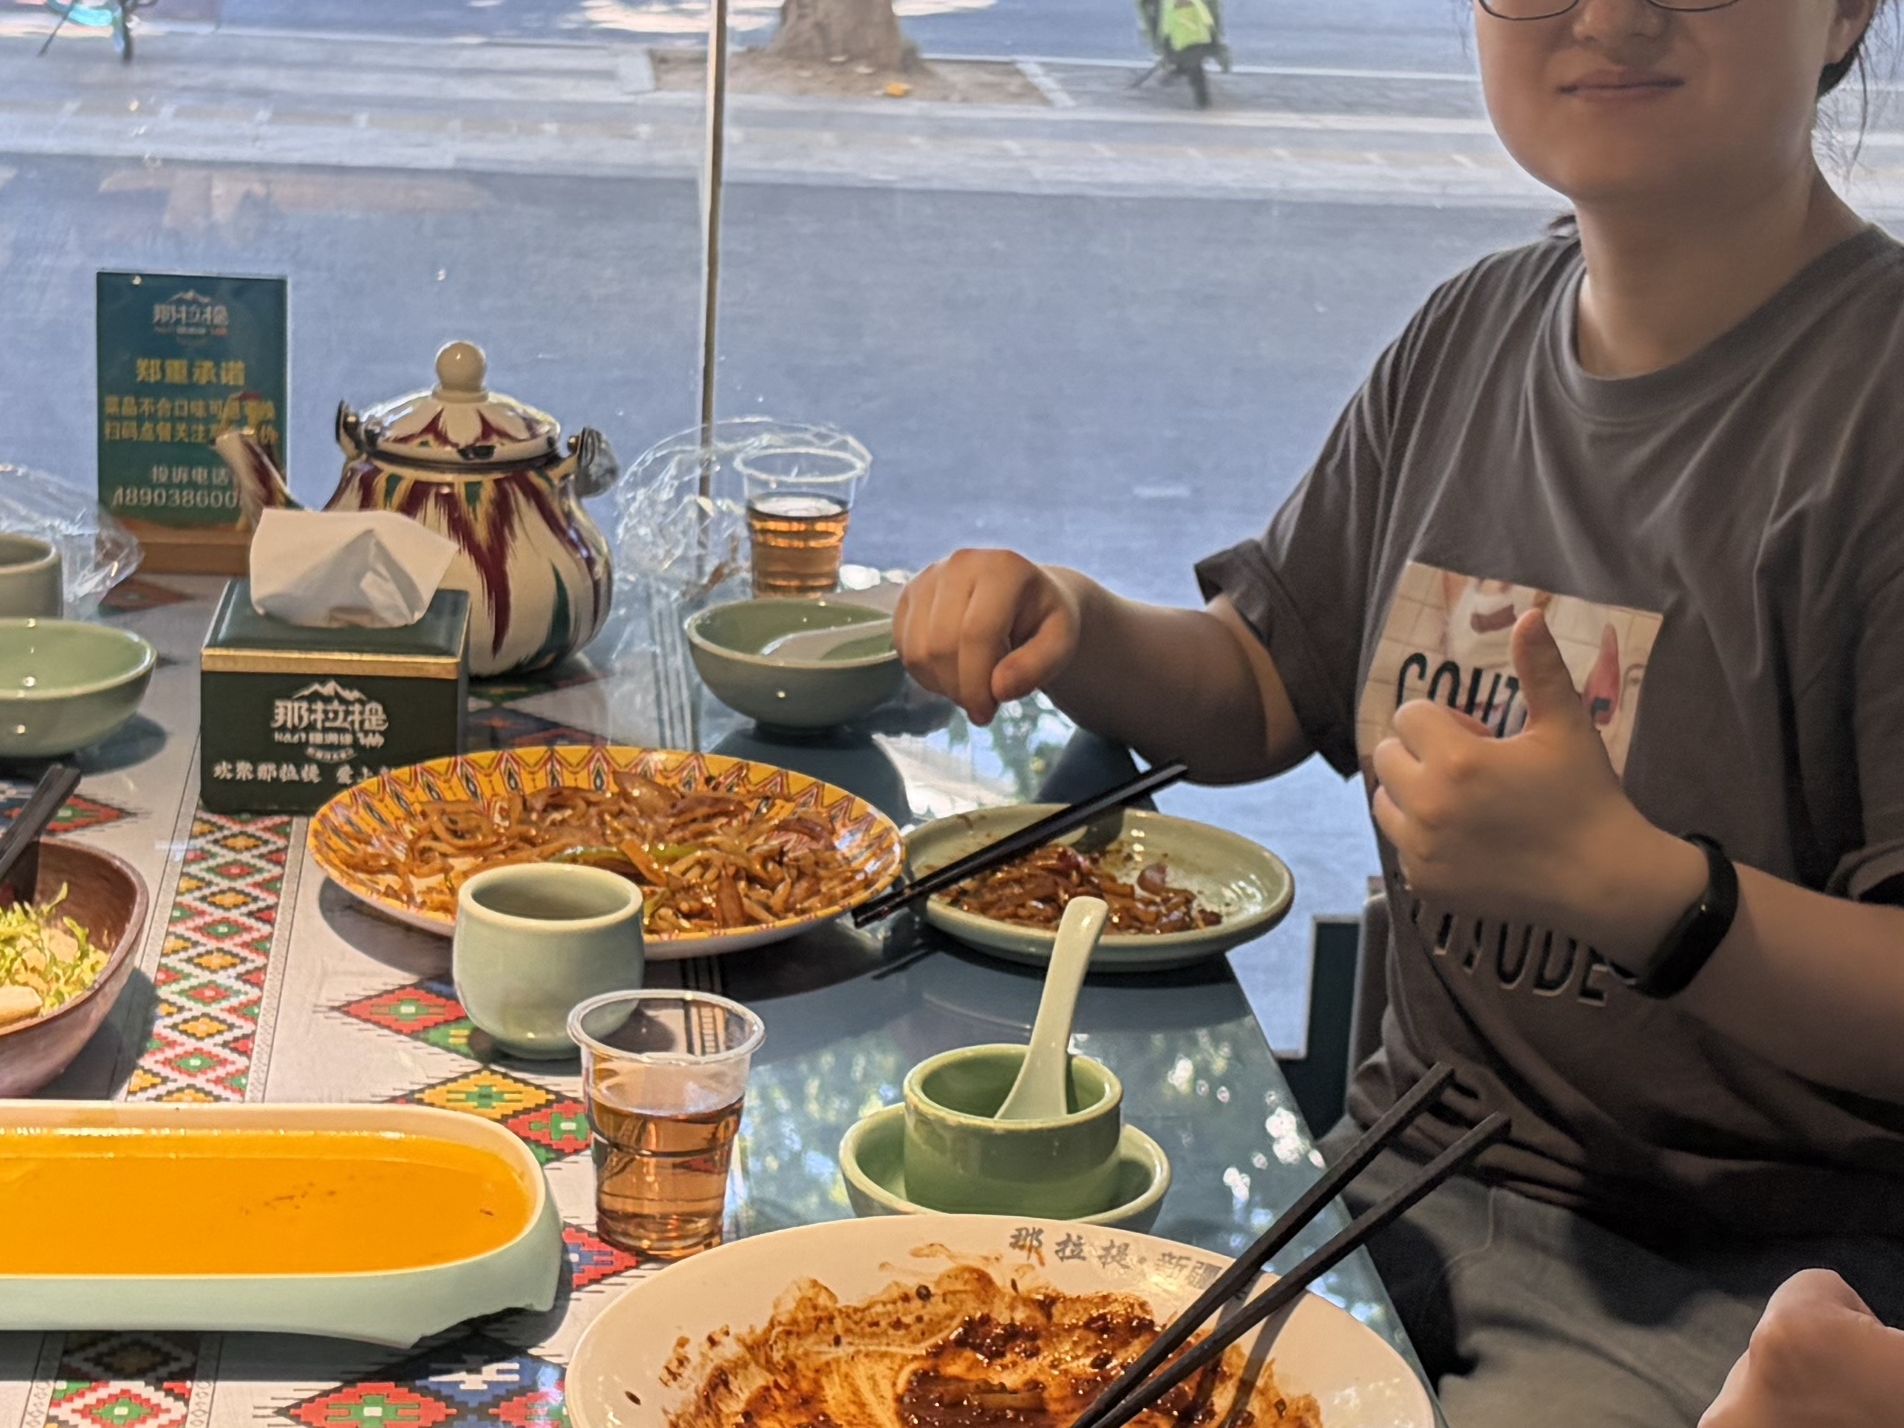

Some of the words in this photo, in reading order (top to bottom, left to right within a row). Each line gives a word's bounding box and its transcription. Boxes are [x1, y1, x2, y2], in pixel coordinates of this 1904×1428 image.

[136, 358, 245, 385] 郑重承诺
[112, 488, 241, 508] 189038600
[270, 699, 389, 730] 那拉提
[336, 764, 395, 784] 爱上
